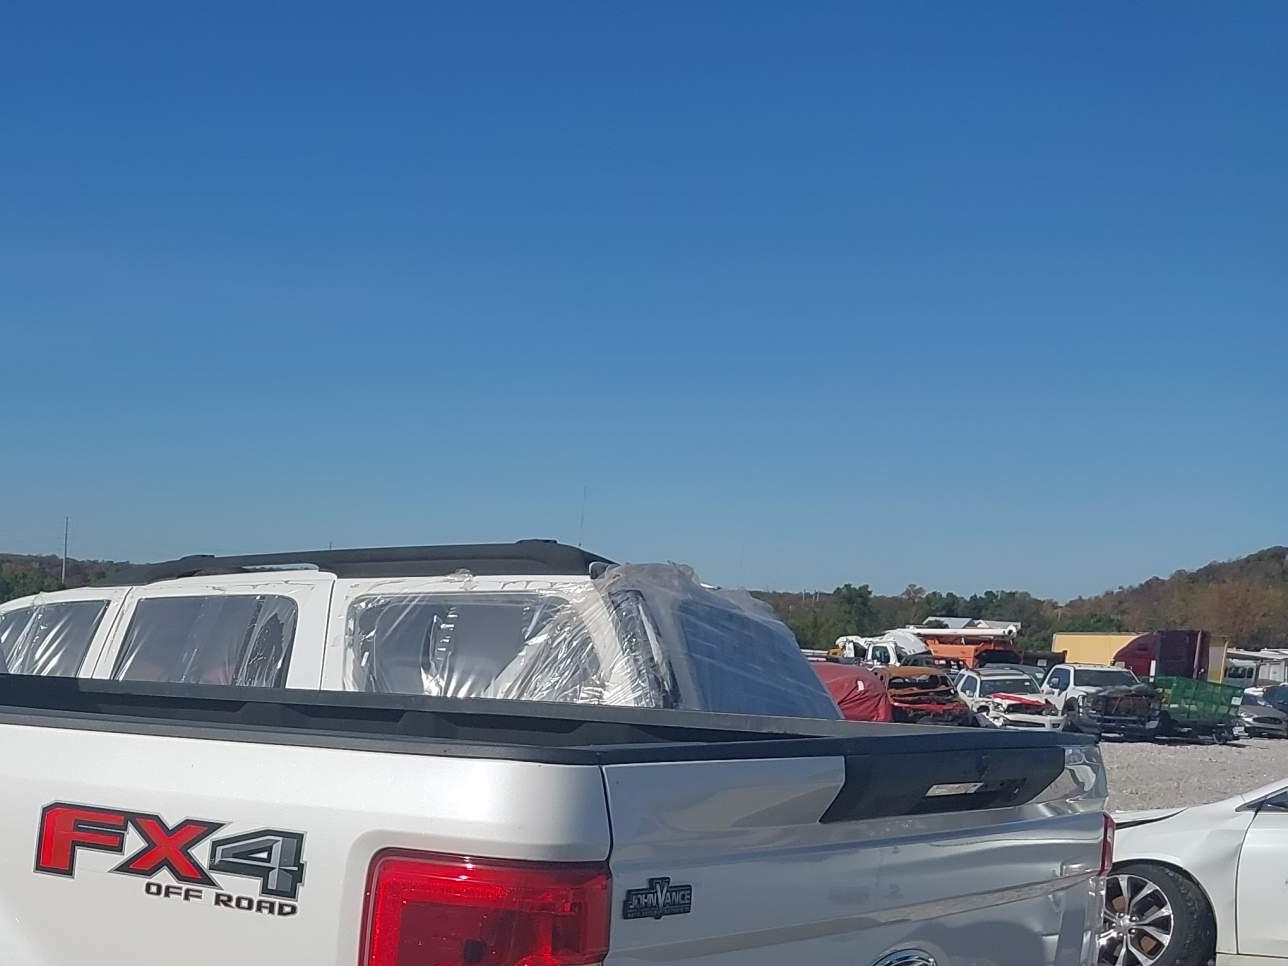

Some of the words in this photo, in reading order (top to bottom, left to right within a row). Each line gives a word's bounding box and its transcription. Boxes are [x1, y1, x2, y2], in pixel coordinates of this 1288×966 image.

[33, 801, 307, 900] FX4
[144, 882, 203, 902] OFF
[214, 891, 298, 917] ROAD
